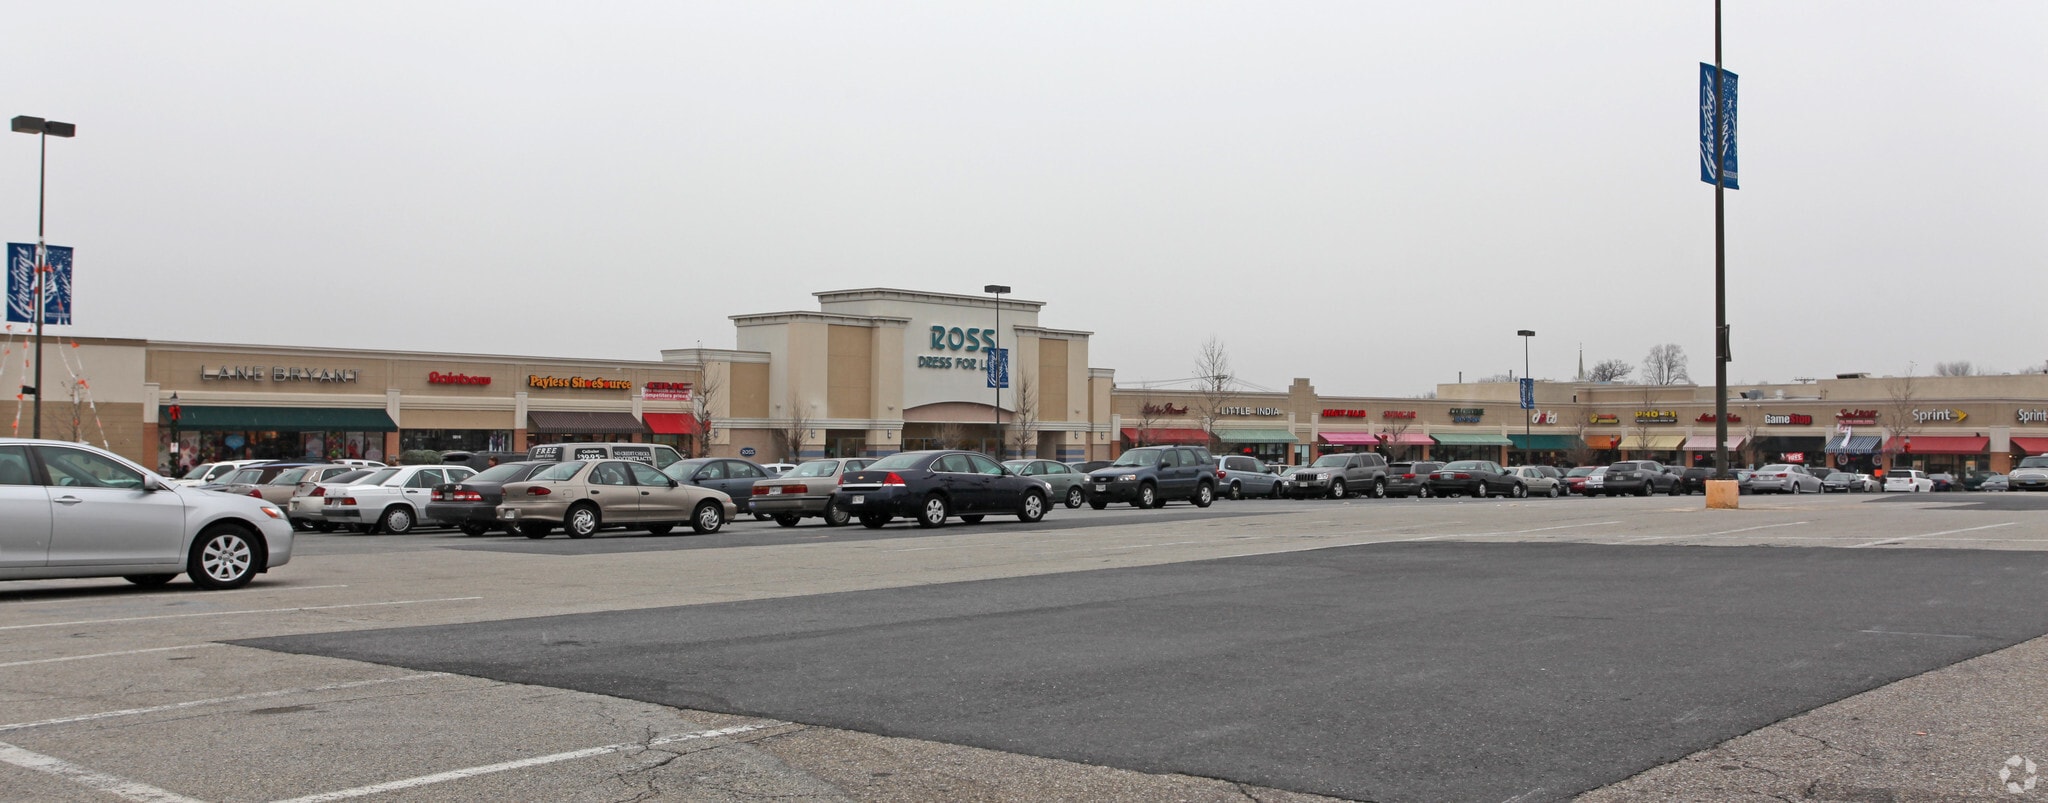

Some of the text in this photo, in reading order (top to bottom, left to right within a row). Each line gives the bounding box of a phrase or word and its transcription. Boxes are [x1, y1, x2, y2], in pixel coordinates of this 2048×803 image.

[930, 325, 996, 353] ROSS
[917, 356, 953, 369] DRESS
[955, 357, 977, 370] FOR
[201, 365, 362, 384] LANE BRYANT
[428, 371, 492, 386] Rainbow
[528, 374, 570, 390] Payless
[571, 376, 632, 390] ShoeSource
[1221, 406, 1280, 416] LITTLE INDIA
[1912, 409, 1950, 423] Sprint
[2017, 409, 2047, 424] Sprint
[1764, 413, 1812, 425] GameStop
[536, 447, 557, 455] FREE
